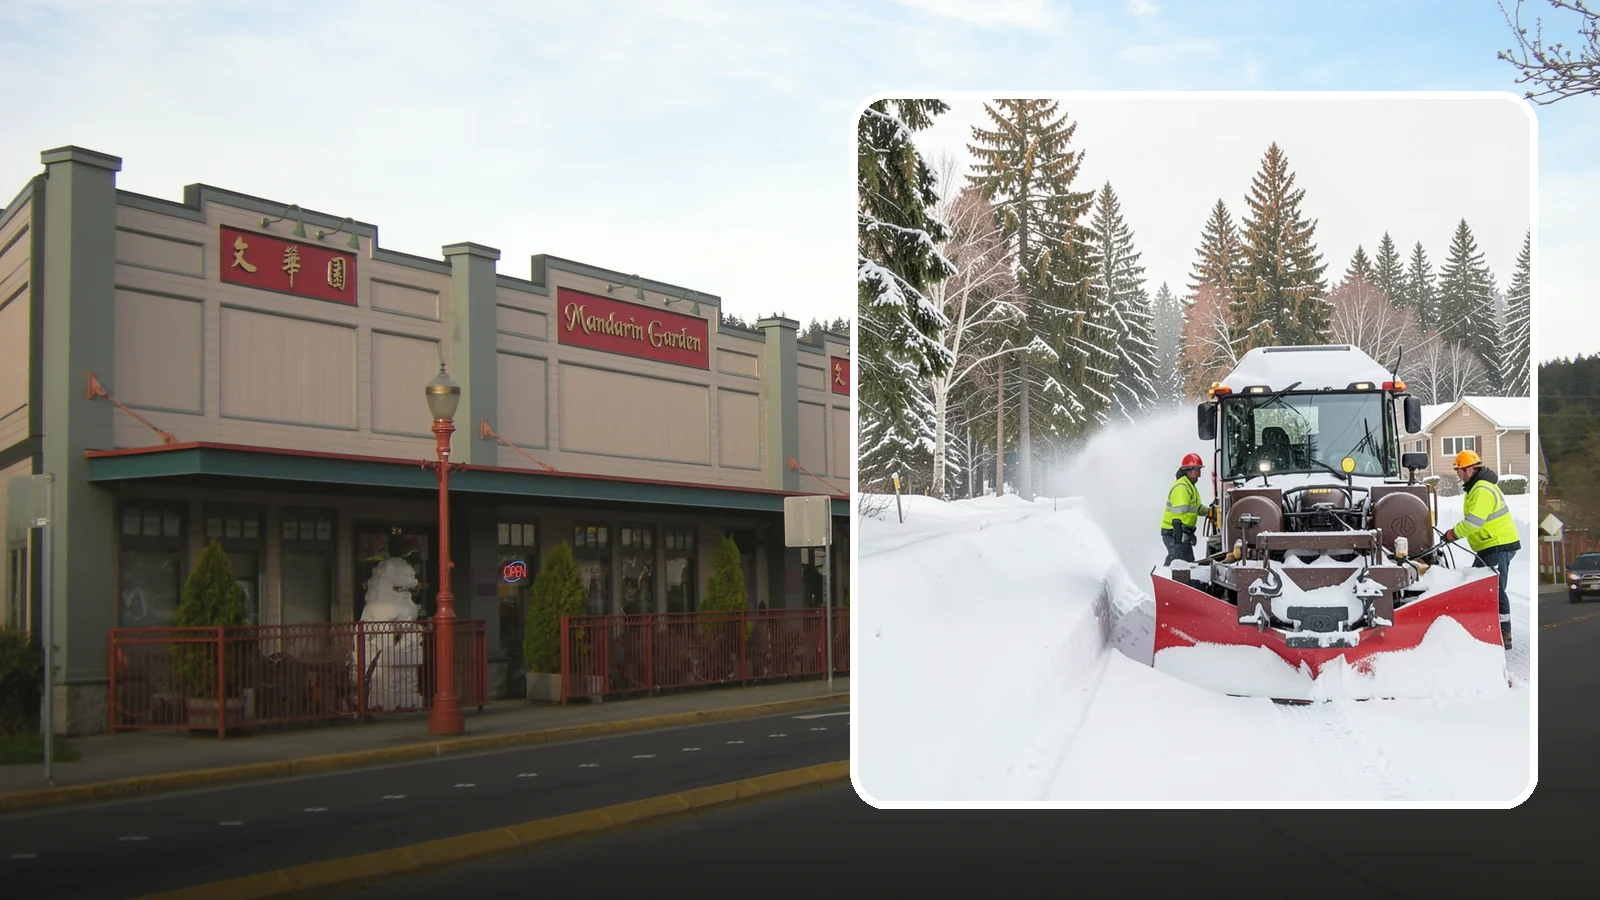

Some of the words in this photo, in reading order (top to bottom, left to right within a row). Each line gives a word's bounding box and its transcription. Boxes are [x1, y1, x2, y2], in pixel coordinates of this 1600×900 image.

[230, 235, 346, 291] 文華園
[564, 302, 644, 341] Mandarin
[647, 320, 702, 352] Garden
[503, 566, 527, 578] OPEN
